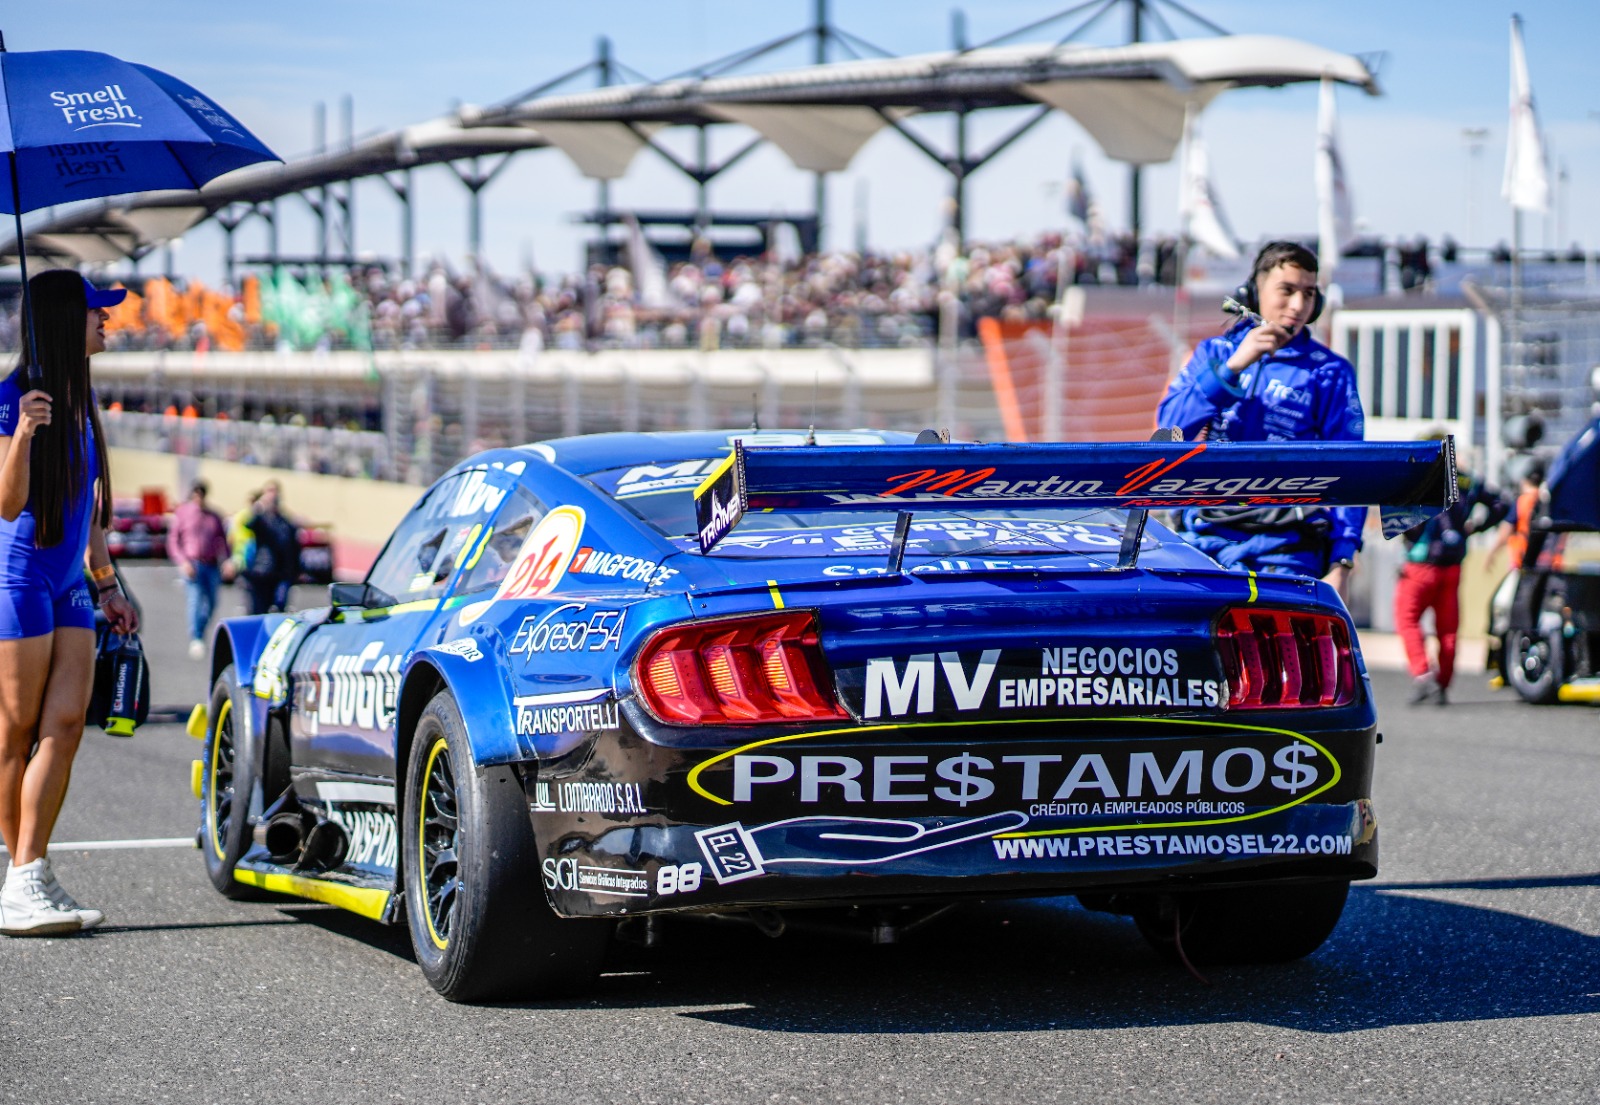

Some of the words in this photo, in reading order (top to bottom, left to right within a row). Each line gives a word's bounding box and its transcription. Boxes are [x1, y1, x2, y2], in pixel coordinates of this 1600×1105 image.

[50, 84, 127, 107] Smell
[878, 467, 1103, 497] Martin
[1115, 443, 1341, 497] Vazquez
[831, 533, 930, 547] EL
[945, 529, 1122, 546] PATO
[580, 550, 680, 588] MAGFORCE
[1041, 647, 1179, 676] NEGOCIOS
[863, 649, 1002, 719] MV
[999, 677, 1220, 708] EMPRESARIALES
[514, 688, 620, 735] TRANSPORTELLI
[557, 782, 615, 813] LOMBARDO
[1029, 800, 1088, 817] CRÉDITO
[1091, 803, 1101, 816] A
[1104, 802, 1186, 815] EMPLEADOS
[1187, 799, 1246, 815] PÚBLICOS
[707, 832, 736, 854] EL
[992, 833, 1352, 860] WWW.PRESTAMOSEL22.COM
[542, 857, 580, 891] SGI
[718, 852, 752, 874] 22
[656, 862, 703, 896] 88
